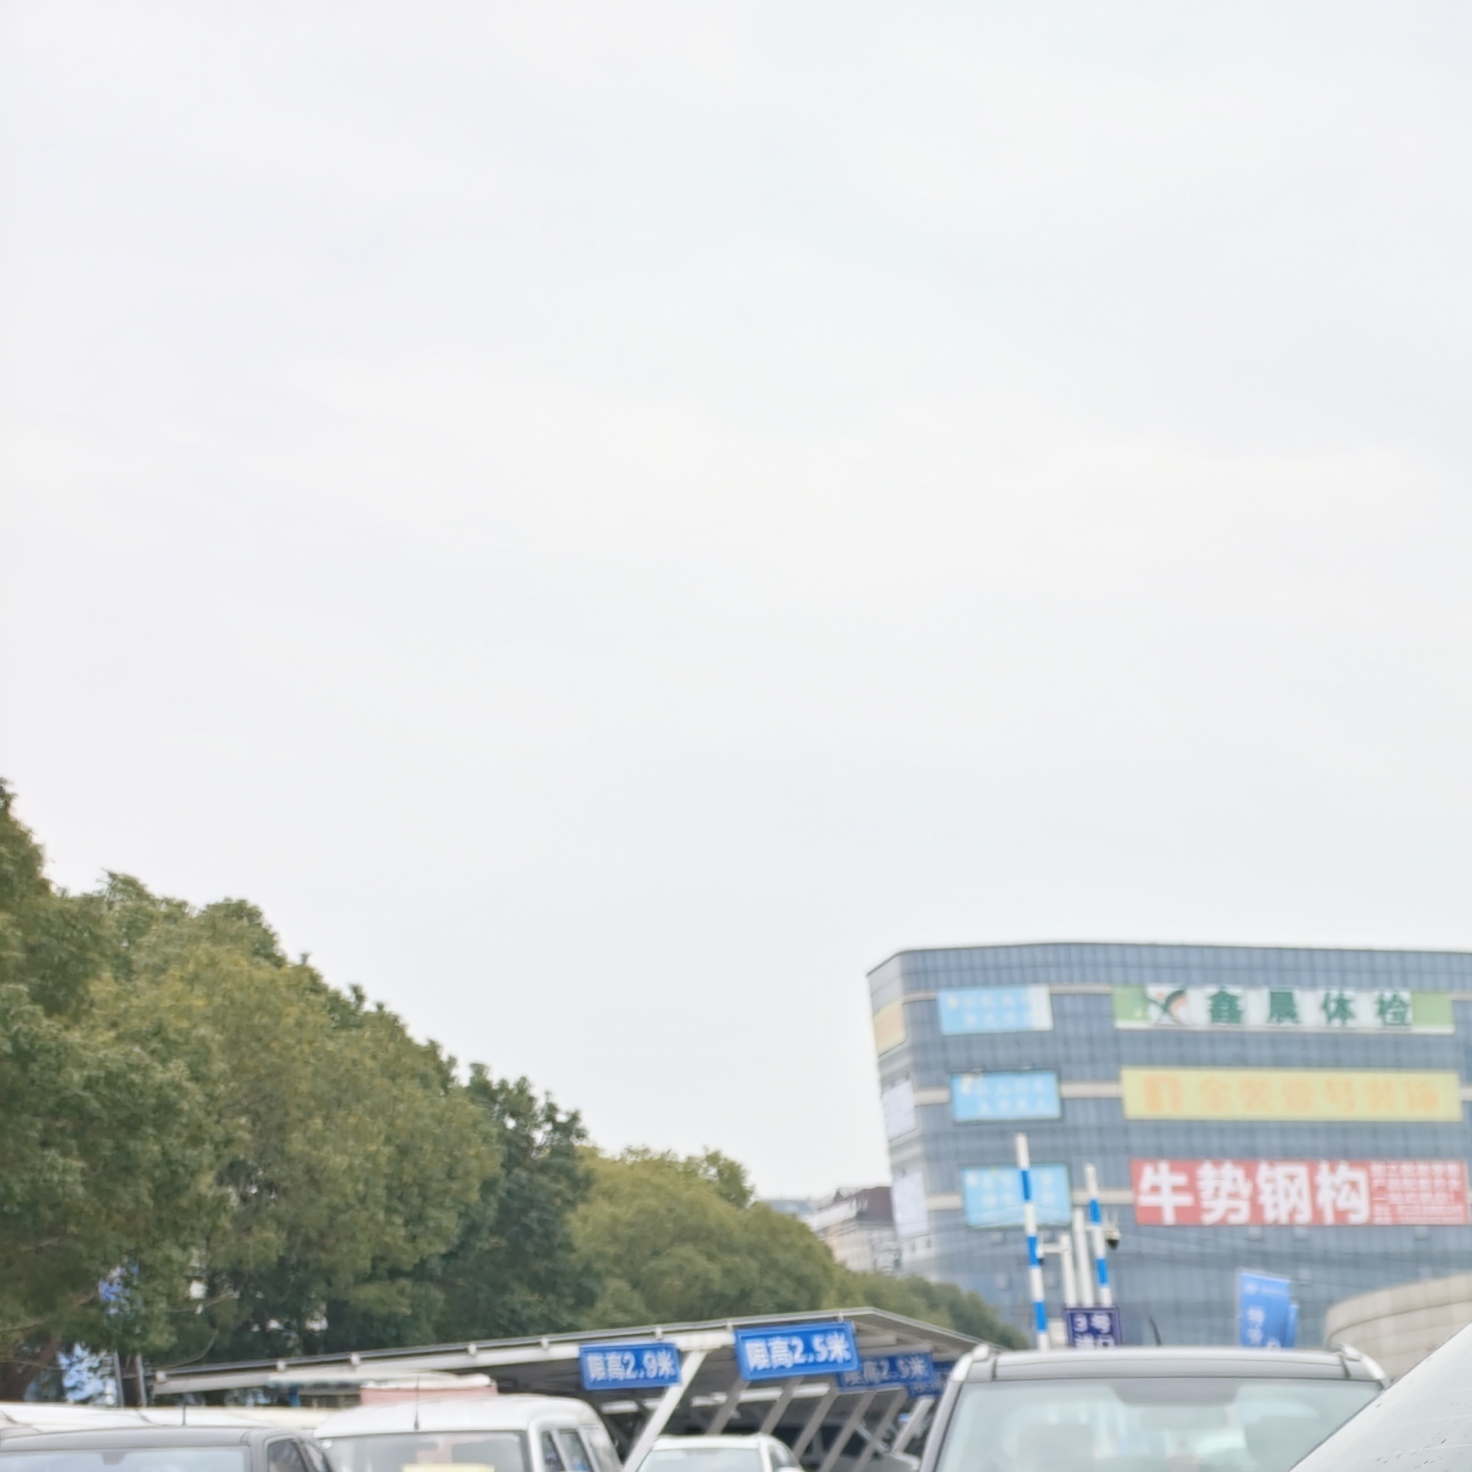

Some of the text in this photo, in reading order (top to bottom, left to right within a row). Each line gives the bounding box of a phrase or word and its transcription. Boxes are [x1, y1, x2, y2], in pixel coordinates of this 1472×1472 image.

[1137, 1160, 1371, 1225] 牛势钢构
[586, 1349, 676, 1382] 限高2.9米
[744, 1332, 853, 1372] 限高2.5米
